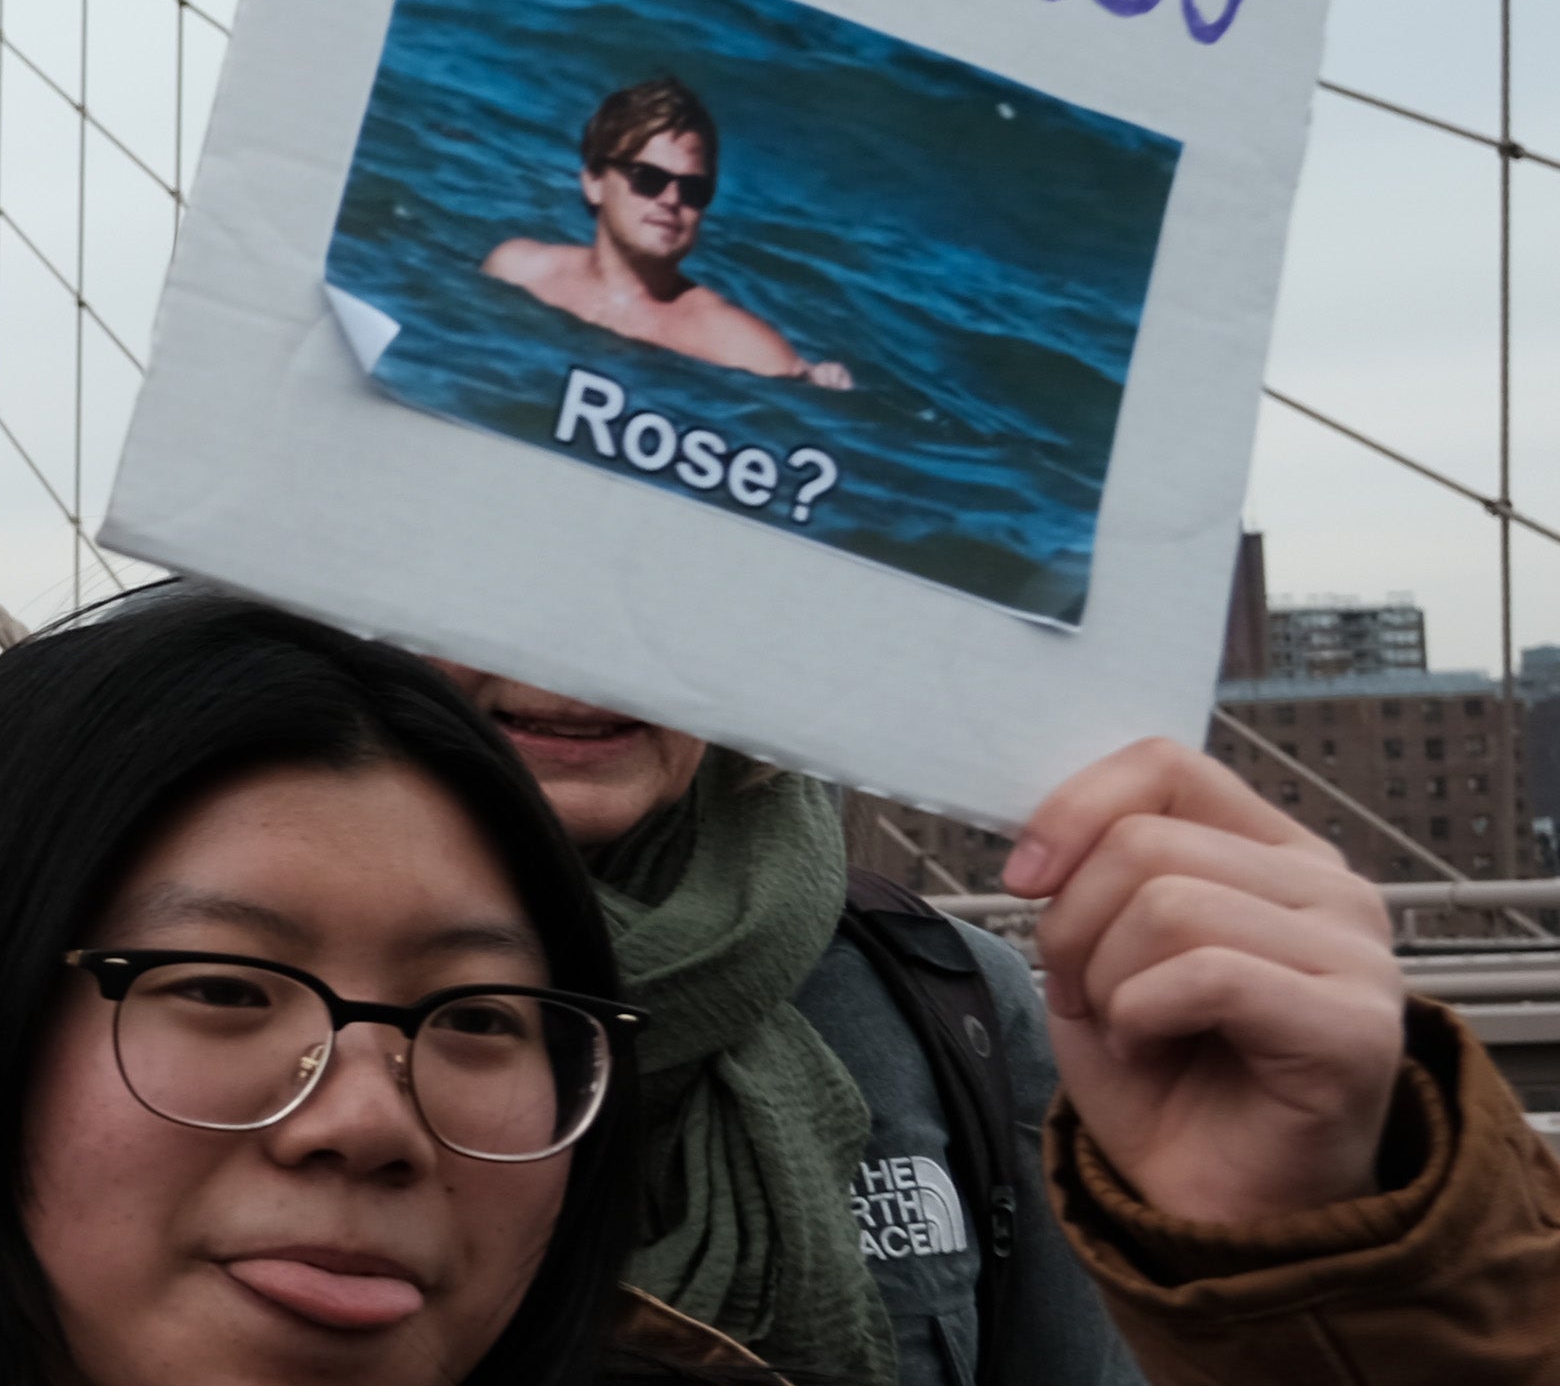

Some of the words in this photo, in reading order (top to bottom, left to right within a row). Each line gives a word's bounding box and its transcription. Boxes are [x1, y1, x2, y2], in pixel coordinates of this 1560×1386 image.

[554, 368, 838, 522] Rose?
[849, 1156, 917, 1195] HE
[849, 1190, 924, 1227] RTH
[859, 1222, 932, 1261] ACE
